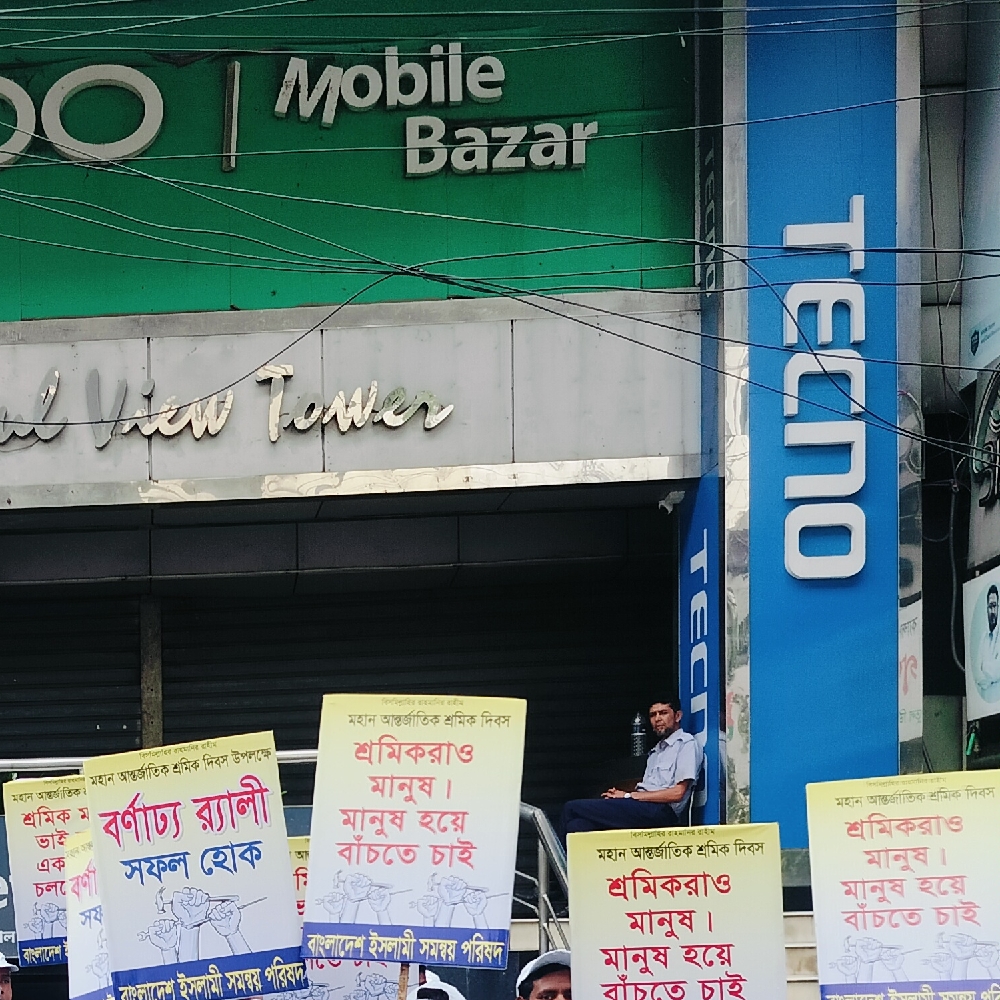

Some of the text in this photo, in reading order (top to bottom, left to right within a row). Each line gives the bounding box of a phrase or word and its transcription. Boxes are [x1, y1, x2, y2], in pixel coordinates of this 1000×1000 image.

[274, 43, 506, 127] Mobile
[404, 115, 598, 178] Bazar
[783, 194, 866, 579] TECNO
[85, 368, 235, 450] View
[256, 363, 455, 443] Tower
[354, 734, 474, 766] শ্রমিকরাও
[21, 805, 71, 828] শ্রমিক
[339, 807, 407, 838] মানুষ
[845, 812, 964, 841] শ্রমিকরাও
[119, 840, 264, 886] সফল হোক
[429, 837, 477, 870] চাই
[606, 867, 732, 901] শ্রমিকরাও
[839, 877, 907, 904] মানুষ
[932, 900, 982, 927] চাই
[600, 945, 671, 976] মানুষ
